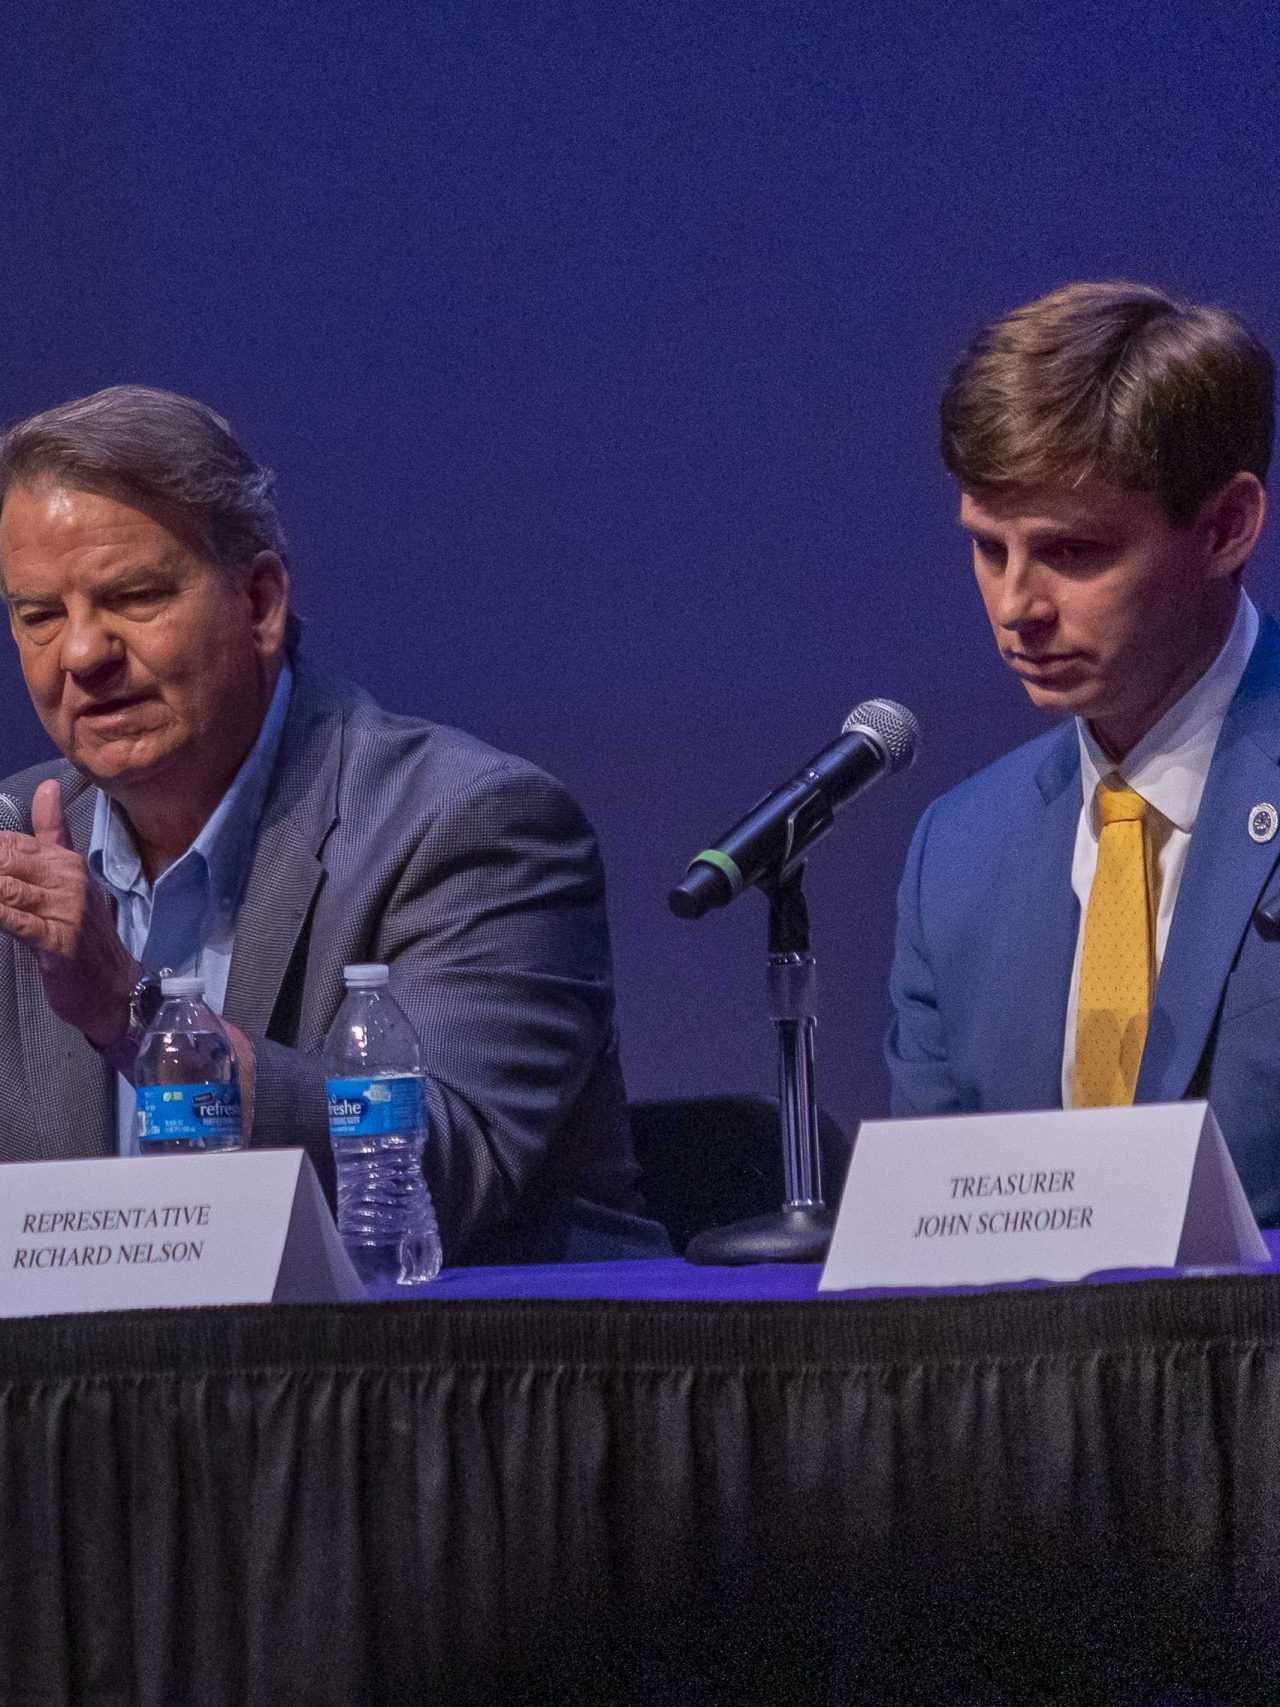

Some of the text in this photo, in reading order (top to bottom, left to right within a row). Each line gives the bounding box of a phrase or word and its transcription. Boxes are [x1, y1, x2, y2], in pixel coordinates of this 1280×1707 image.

[950, 1169, 1076, 1200] TREASURER
[21, 1204, 211, 1234] REPRESENTATIVE
[912, 1206, 1094, 1239] JOHN SCHRODER
[12, 1240, 205, 1270] RICHARD NELSON
